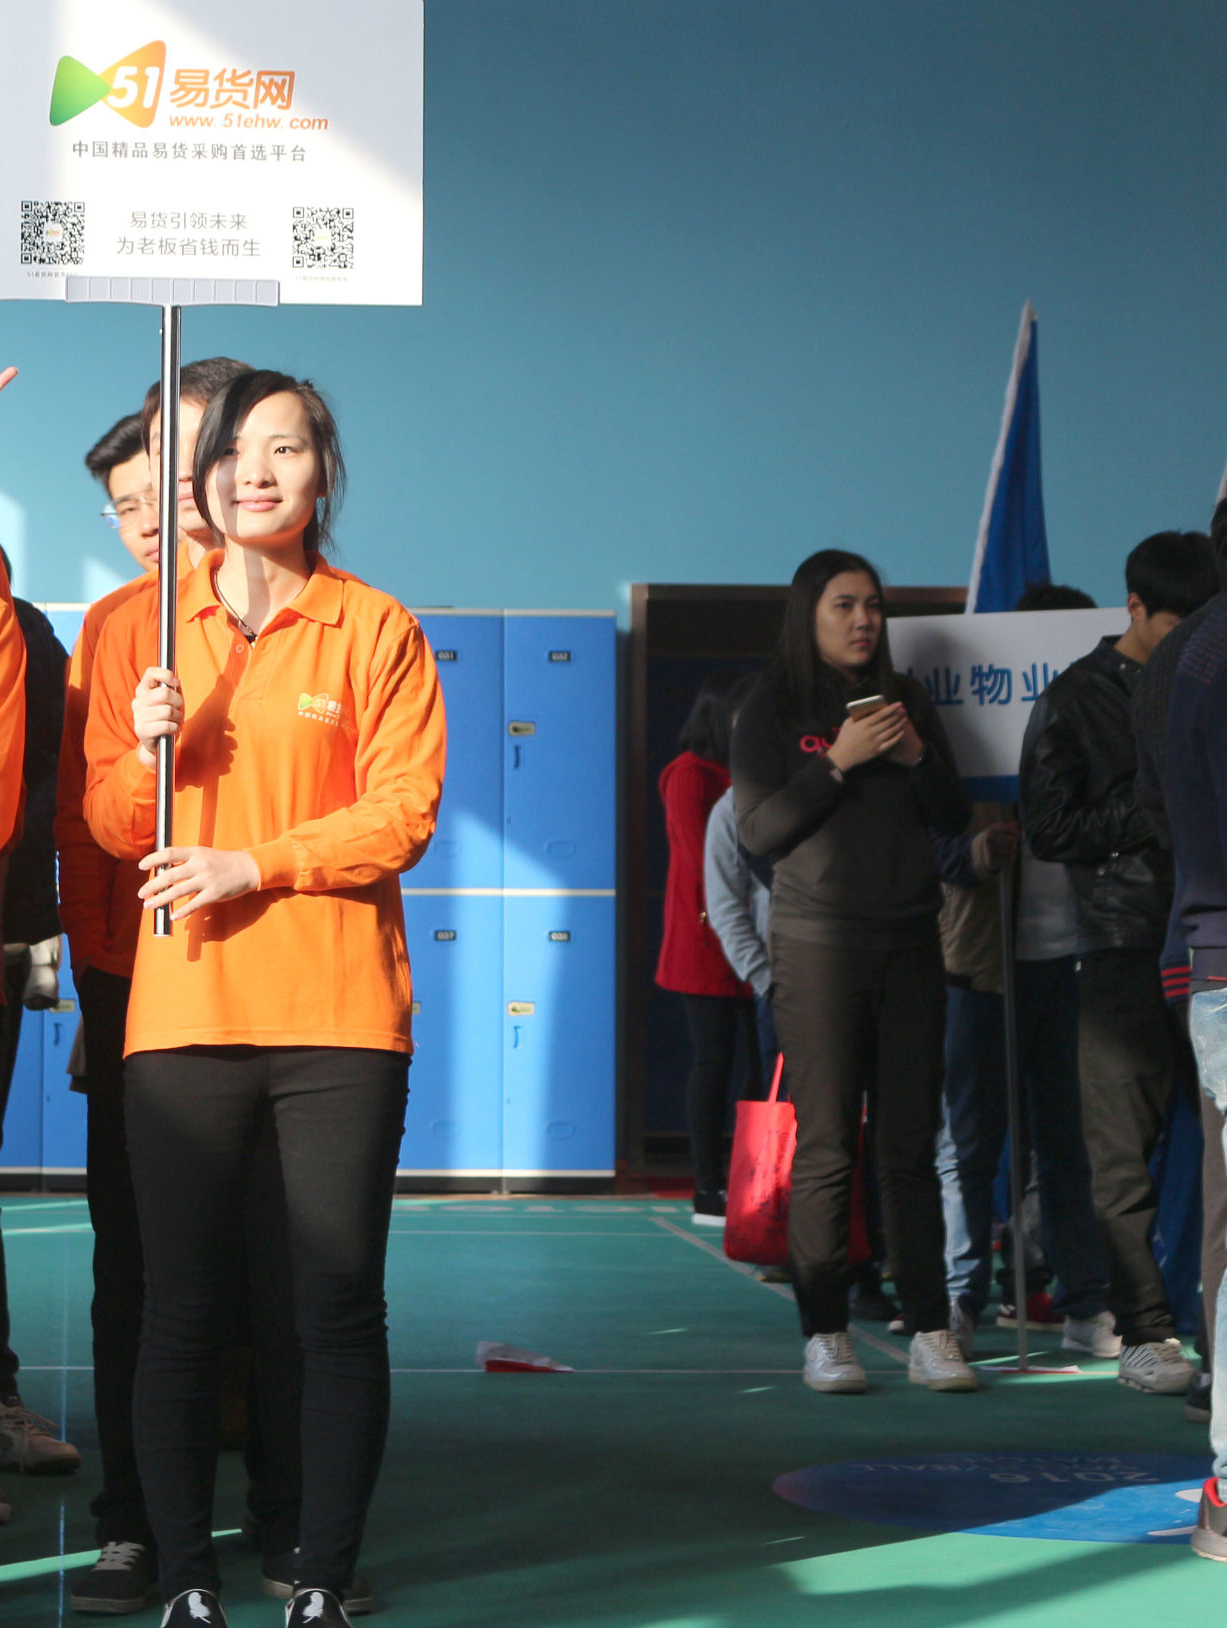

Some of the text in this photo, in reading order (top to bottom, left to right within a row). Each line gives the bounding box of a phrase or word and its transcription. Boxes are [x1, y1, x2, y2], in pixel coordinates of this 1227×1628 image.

[107, 66, 295, 110] 51 易货网
[72, 140, 307, 162] 中国精品易货采购首选平台
[130, 211, 248, 230] 易货引领未来
[116, 236, 261, 257] 为老板省钱而生
[908, 662, 1076, 705] 业物业
